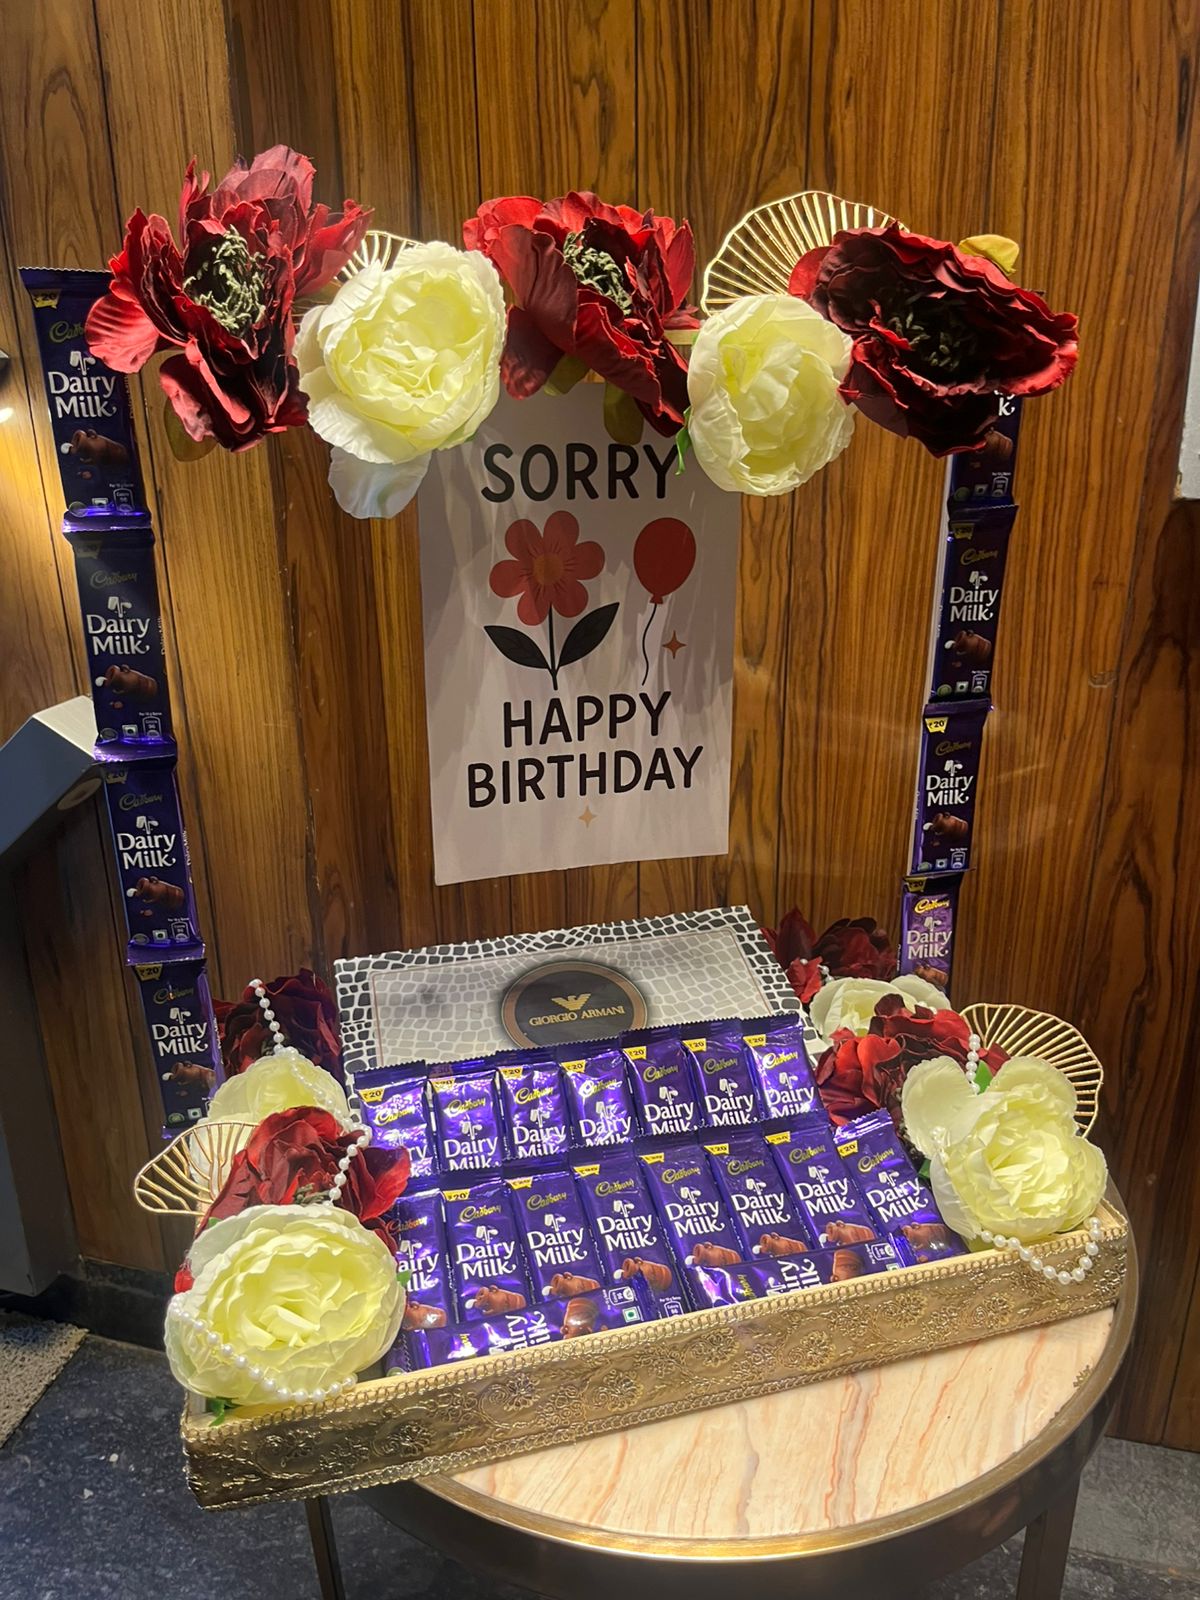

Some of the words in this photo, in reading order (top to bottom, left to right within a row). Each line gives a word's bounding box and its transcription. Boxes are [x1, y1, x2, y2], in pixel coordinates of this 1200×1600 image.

[48, 371, 116, 398] Dairy
[54, 396, 117, 418] Milk
[481, 442, 678, 503] SORRY
[950, 586, 999, 606] Dairy
[950, 604, 994, 622] Milk
[86, 614, 150, 638] Dairy
[92, 635, 150, 655] Milk
[503, 690, 671, 748] HAPPY
[467, 745, 704, 808] BIRTHDAY
[925, 775, 973, 791] Dairy
[927, 790, 969, 806] Milk
[117, 833, 175, 851] Dairy
[122, 850, 176, 870] Milk
[907, 930, 952, 945] Dairy
[908, 944, 949, 960] Milk
[529, 1012, 578, 1027] GIORGIO
[581, 1005, 625, 1019] ARMANI
[152, 1022, 207, 1040] Dairy
[158, 1039, 208, 1057] Milk
[704, 1058, 738, 1075] Cadbury
[763, 1052, 798, 1069] Cadbury
[643, 1065, 678, 1082] Cadbury
[515, 1087, 553, 1104] Cadbury
[704, 1094, 753, 1113] Dairy
[765, 1086, 814, 1108] Dairy
[446, 1098, 486, 1116] Cadbury
[644, 1102, 694, 1122] Dairy
[579, 1116, 631, 1138] Dairy
[651, 1118, 698, 1135] Milk
[711, 1110, 758, 1127] Milk
[512, 1125, 566, 1145] Dairy
[443, 1137, 498, 1158] Dairy
[518, 1144, 561, 1160] Milk
[789, 1145, 826, 1164] Cadbury
[449, 1154, 499, 1171] Milk
[727, 1159, 765, 1176] Cadbury
[858, 1148, 894, 1173] Cadbury
[662, 1167, 700, 1184] Cadbury
[595, 1179, 635, 1197] Cadbury
[795, 1177, 848, 1200] Dairy
[866, 1177, 921, 1208] Dairy
[527, 1192, 567, 1211] Cadbury
[665, 1201, 719, 1221] Dairy
[731, 1192, 784, 1212] Dairy
[805, 1194, 855, 1217] Milk
[878, 1198, 928, 1223] Milk
[460, 1205, 501, 1223] Cadbury
[597, 1214, 652, 1234] Dairy
[740, 1207, 791, 1228] Milk
[674, 1216, 725, 1238] Milk
[527, 1228, 584, 1250] Dairy
[604, 1231, 657, 1252] Milk
[456, 1241, 515, 1264] Dairy
[534, 1244, 588, 1268] Milk
[398, 1253, 439, 1273] airy
[462, 1258, 517, 1280] Milk
[527, 1311, 550, 1344] ilk
